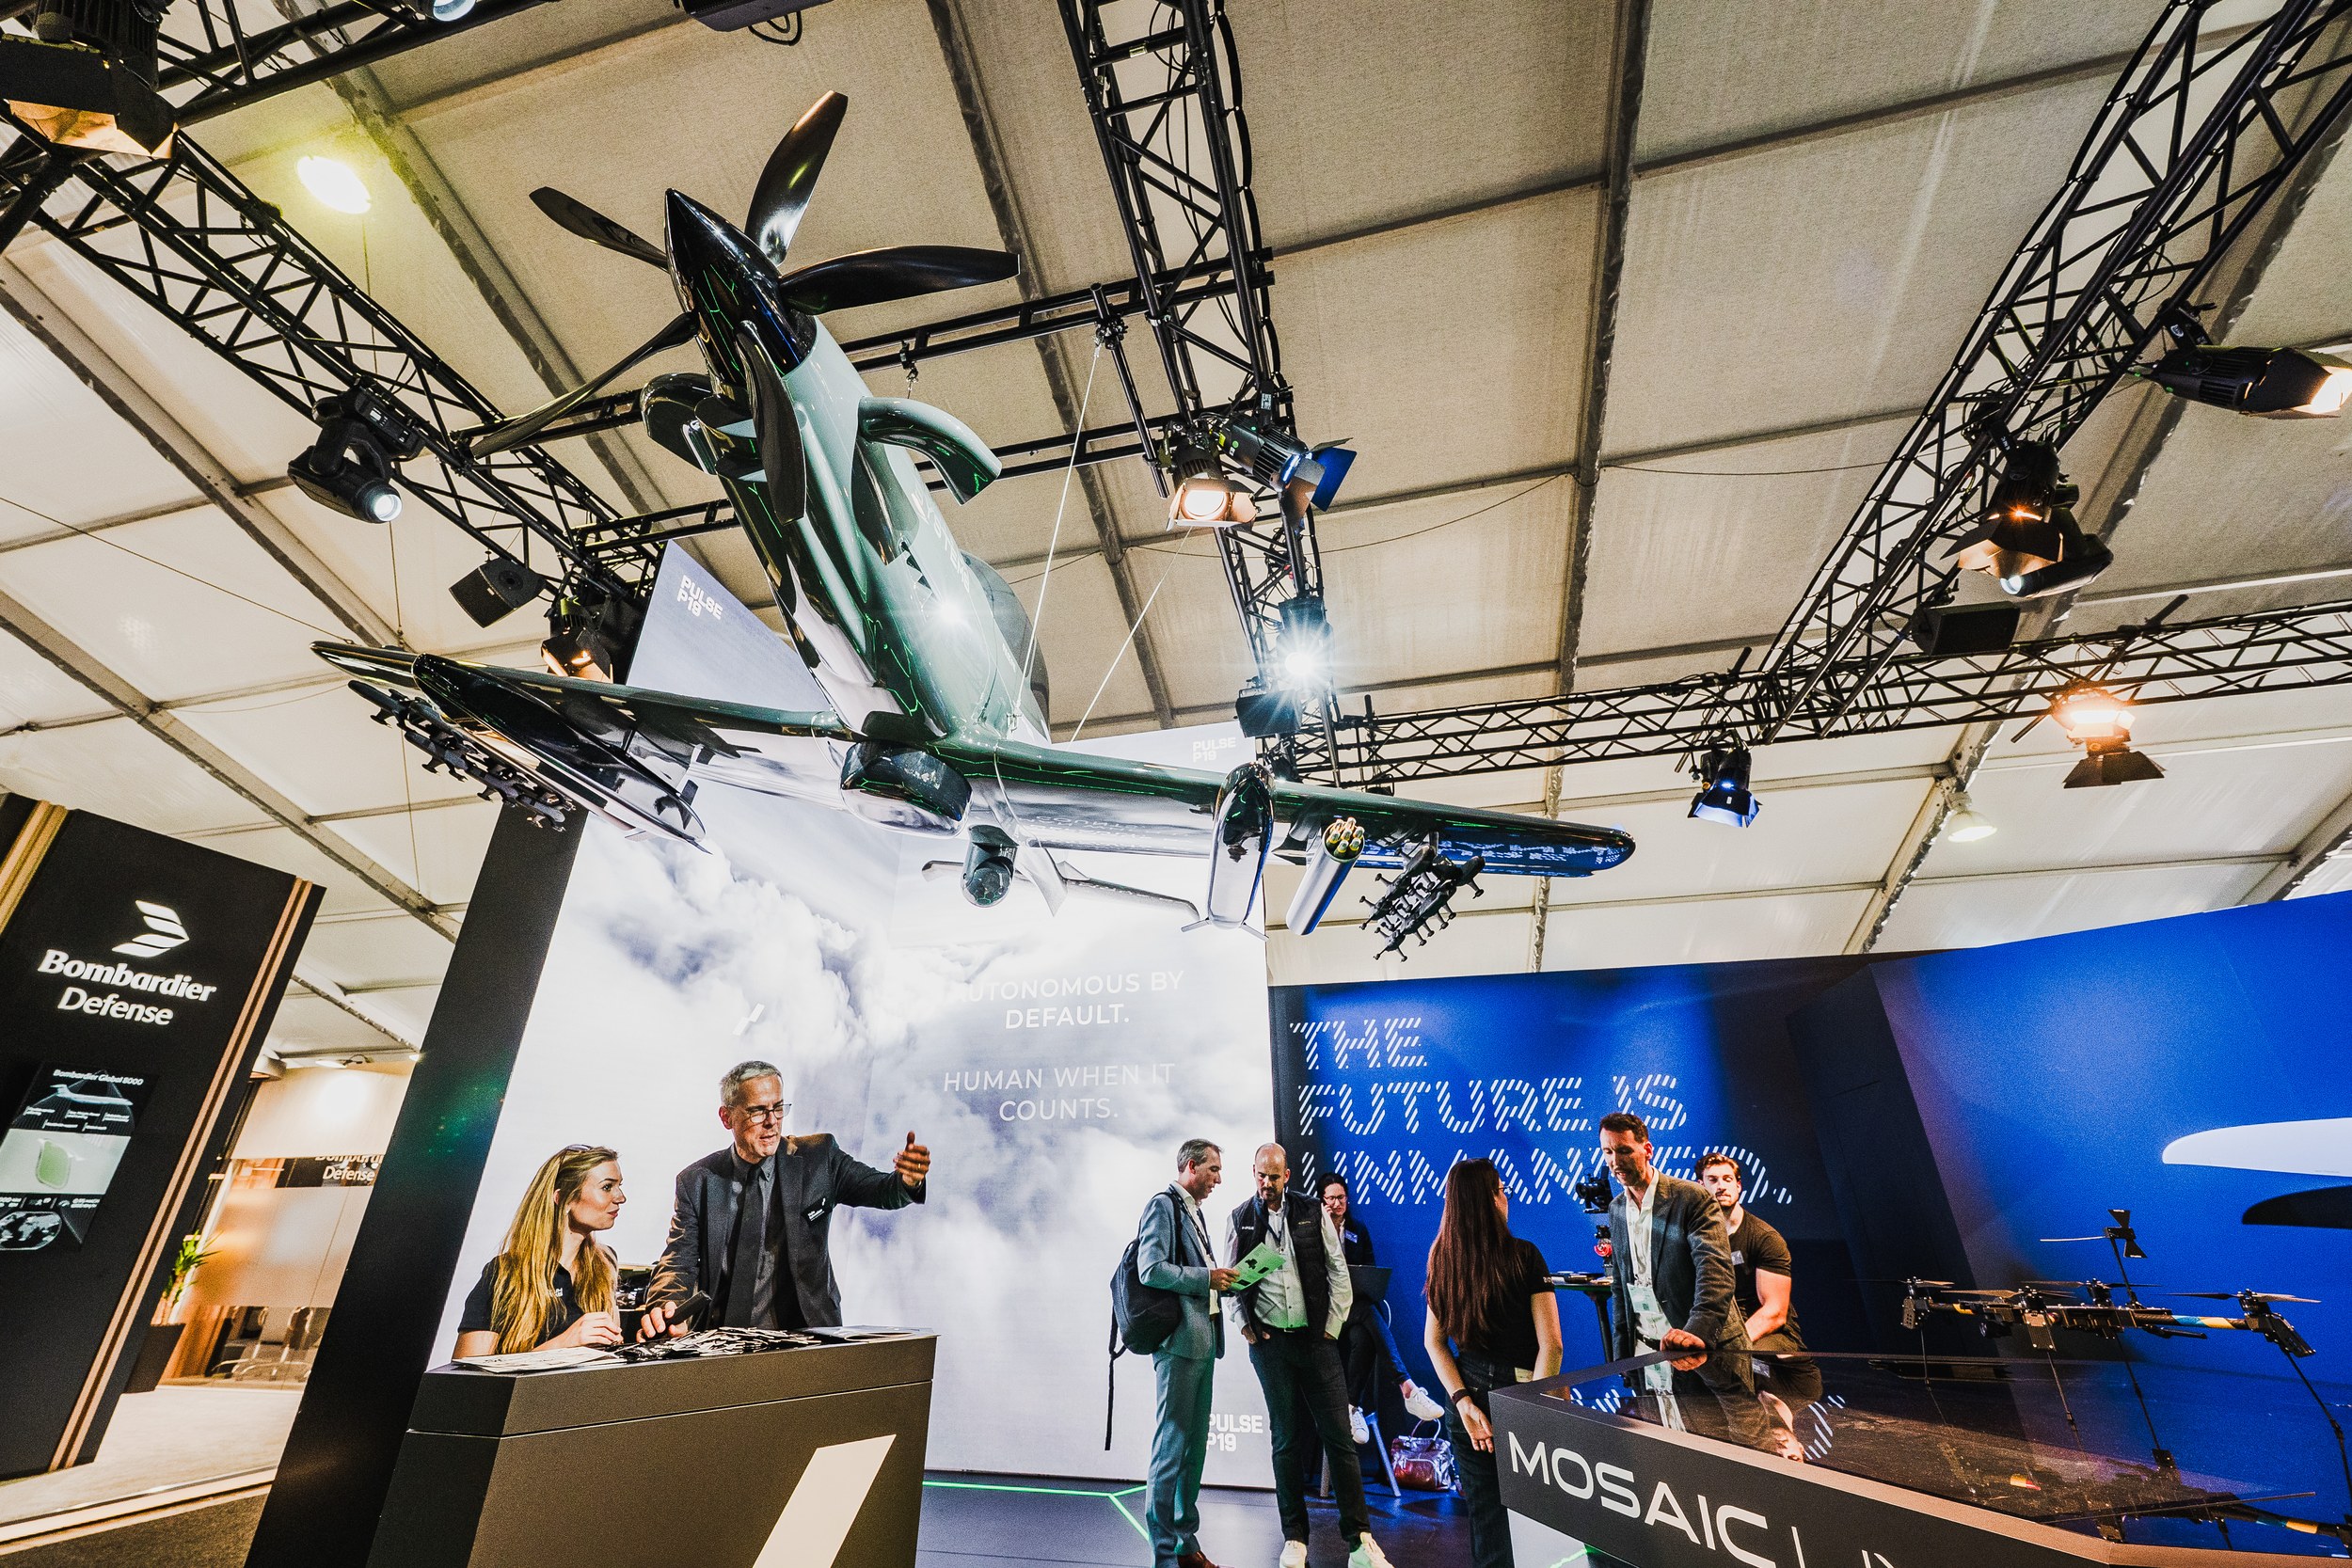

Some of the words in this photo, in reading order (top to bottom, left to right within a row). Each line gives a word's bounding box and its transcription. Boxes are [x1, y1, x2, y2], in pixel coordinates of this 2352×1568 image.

[677, 588, 703, 617] P19
[680, 575, 723, 620] PULSE
[1193, 736, 1236, 752] PULSE
[1193, 750, 1216, 763] P19
[37, 949, 217, 1002] Bombardier
[951, 973, 1140, 1003] UTONOMOUS
[1151, 970, 1184, 992] BY
[57, 987, 174, 1025] Defense
[1005, 1003, 1130, 1029] DEFAULT.
[1290, 1017, 1427, 1069] THE
[944, 1069, 1042, 1092] HUMAN
[1054, 1065, 1139, 1087] WHEN
[1152, 1063, 1175, 1084] IT
[999, 1098, 1119, 1121] COUNTS.
[1298, 1077, 1592, 1135] FUTURE
[1613, 1074, 1687, 1130] IS
[322, 1165, 375, 1181] Defense
[1209, 1414, 1263, 1433] PULSE
[1206, 1432, 1236, 1451] P19
[1508, 1431, 1776, 1568] MOSAIC
